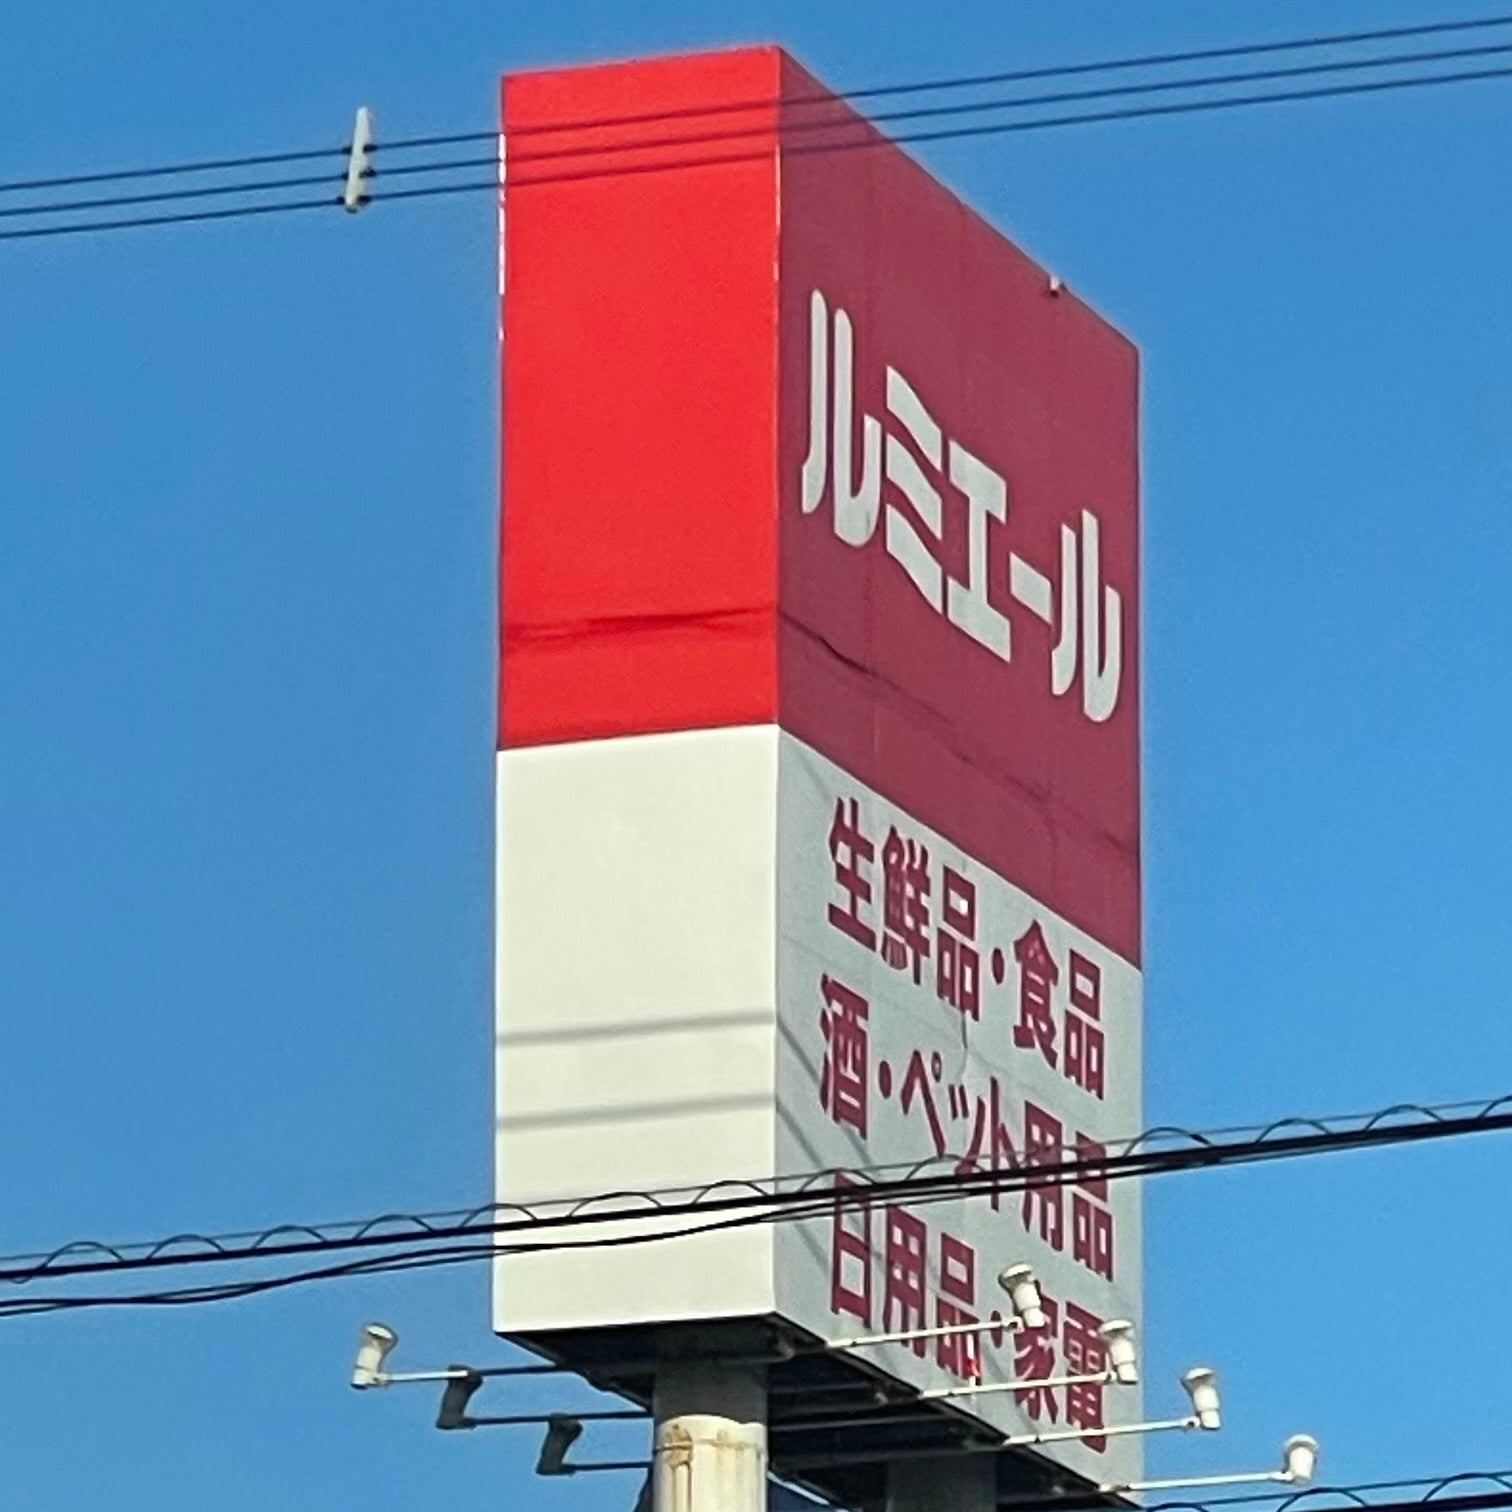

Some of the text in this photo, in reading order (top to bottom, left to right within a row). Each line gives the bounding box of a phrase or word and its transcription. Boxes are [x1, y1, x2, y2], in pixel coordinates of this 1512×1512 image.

[802, 289, 1121, 722] ルミエール
